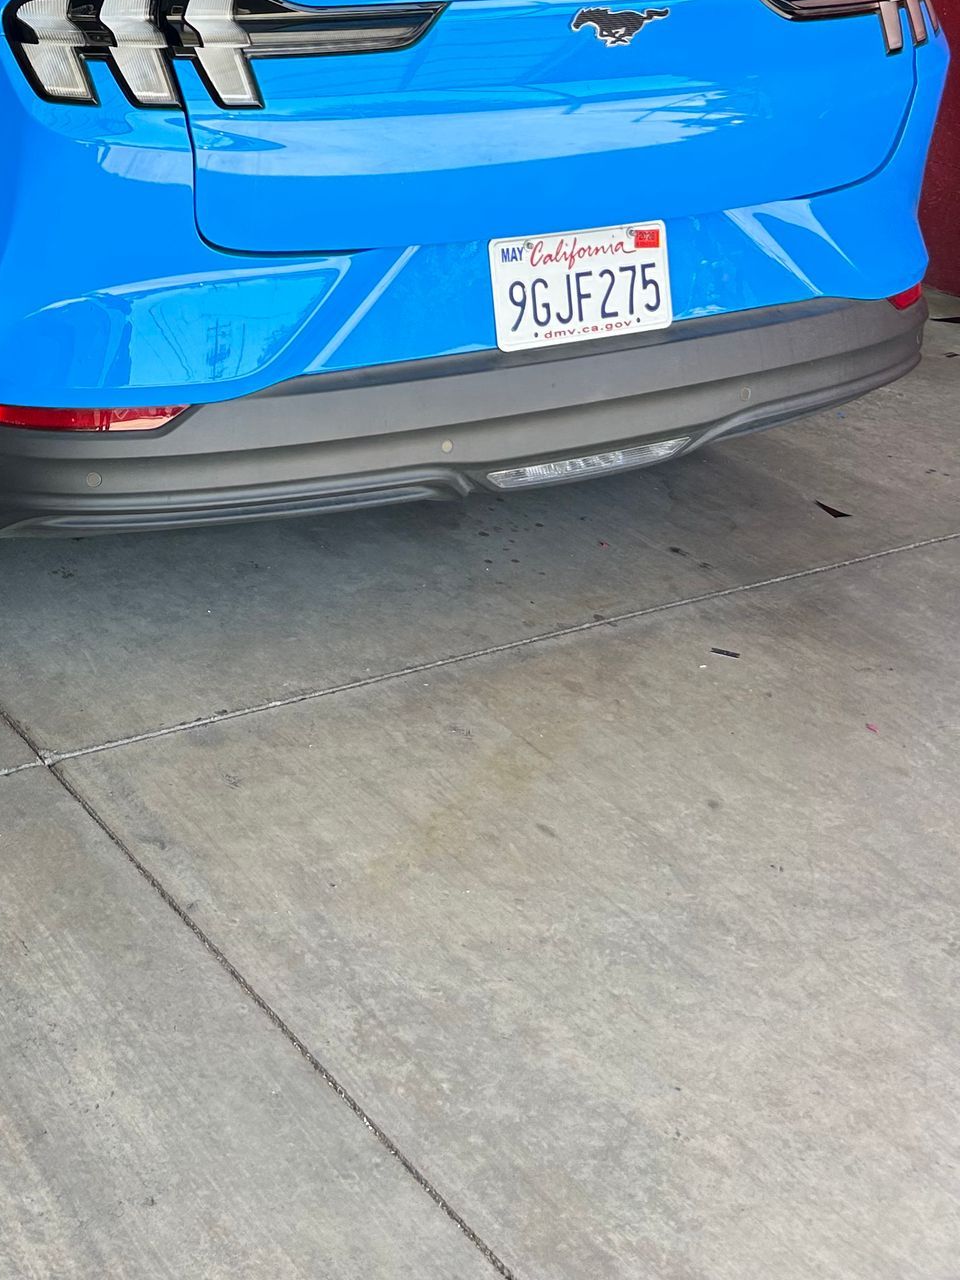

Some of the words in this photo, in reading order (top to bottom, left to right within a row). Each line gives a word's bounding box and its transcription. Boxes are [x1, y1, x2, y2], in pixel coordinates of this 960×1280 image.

[501, 246, 524, 263] MAY
[530, 238, 637, 270] California
[508, 262, 661, 332] 9GJF275
[544, 319, 632, 339] dmv.ca.gov
